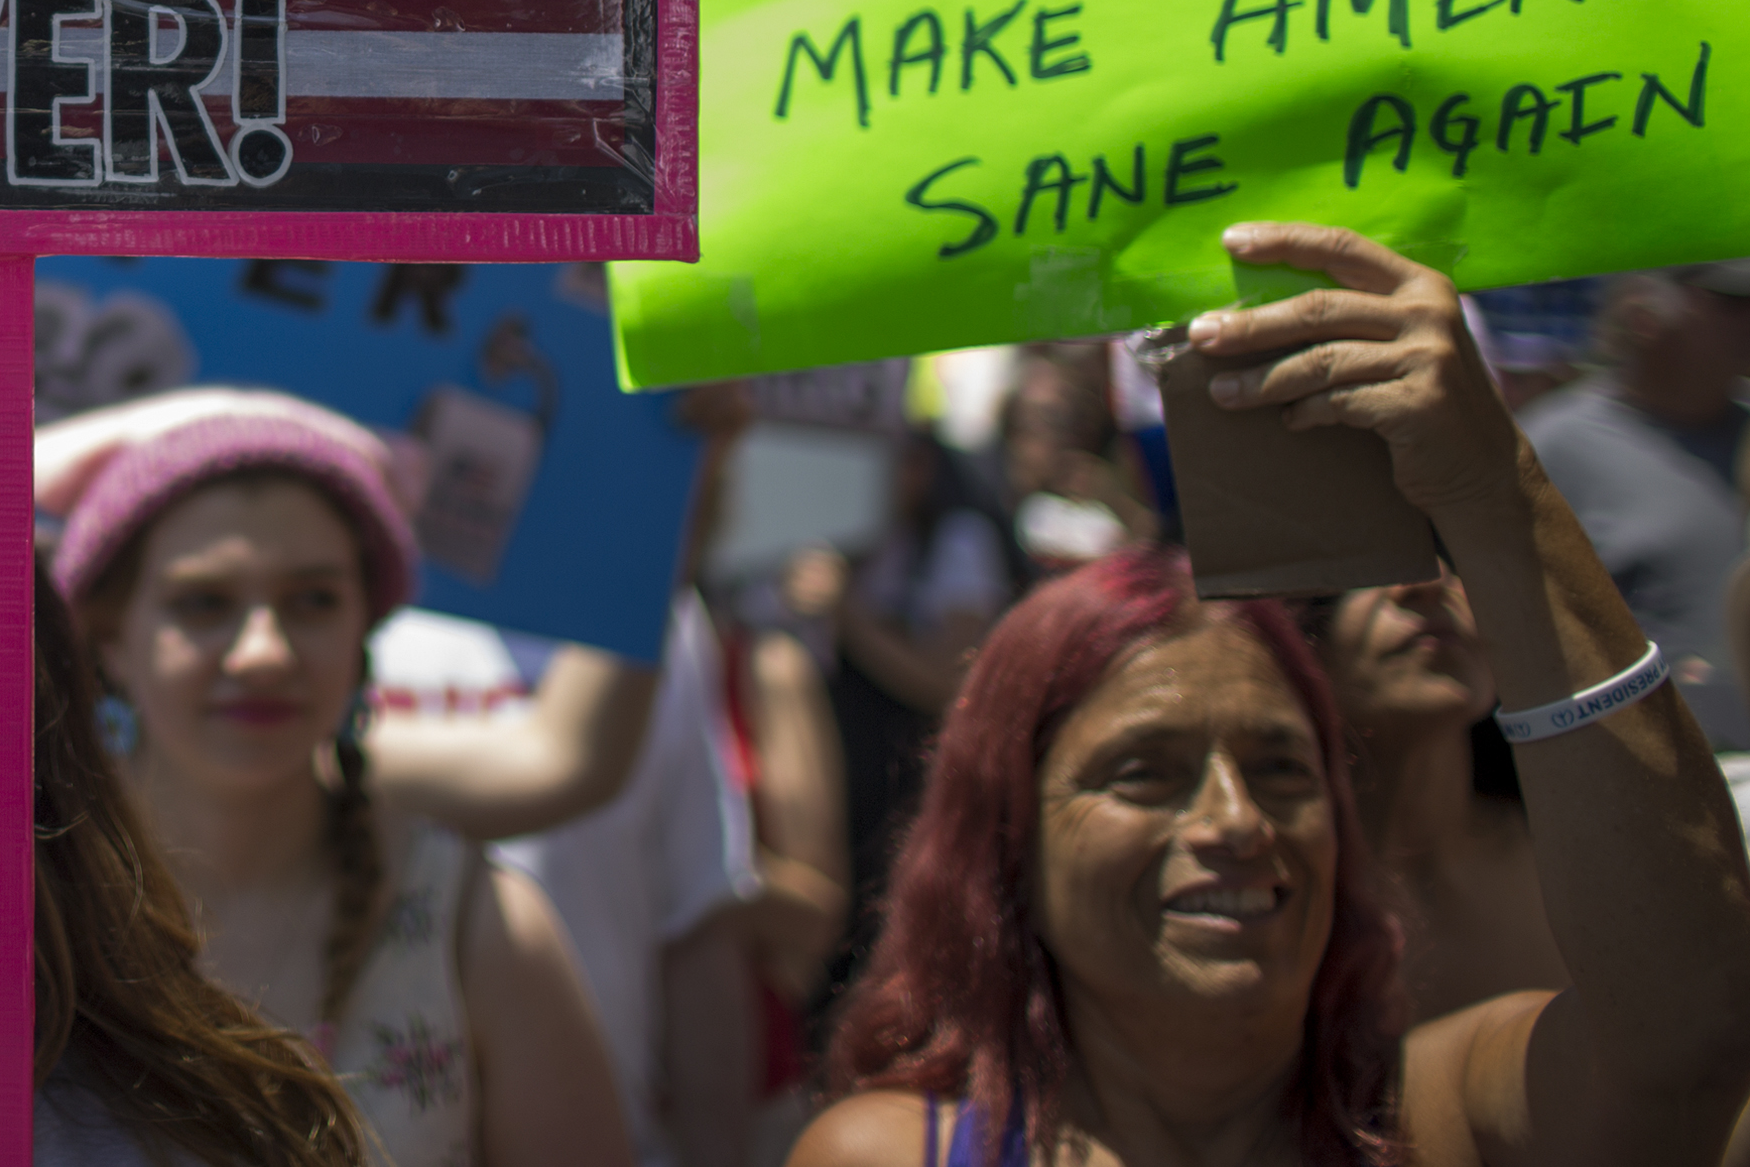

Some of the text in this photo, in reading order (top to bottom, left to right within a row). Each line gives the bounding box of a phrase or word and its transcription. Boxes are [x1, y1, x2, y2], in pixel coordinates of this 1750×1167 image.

[905, 41, 1711, 259] SANE AGAIN
[1577, 668, 1660, 721] PRESIDENT
